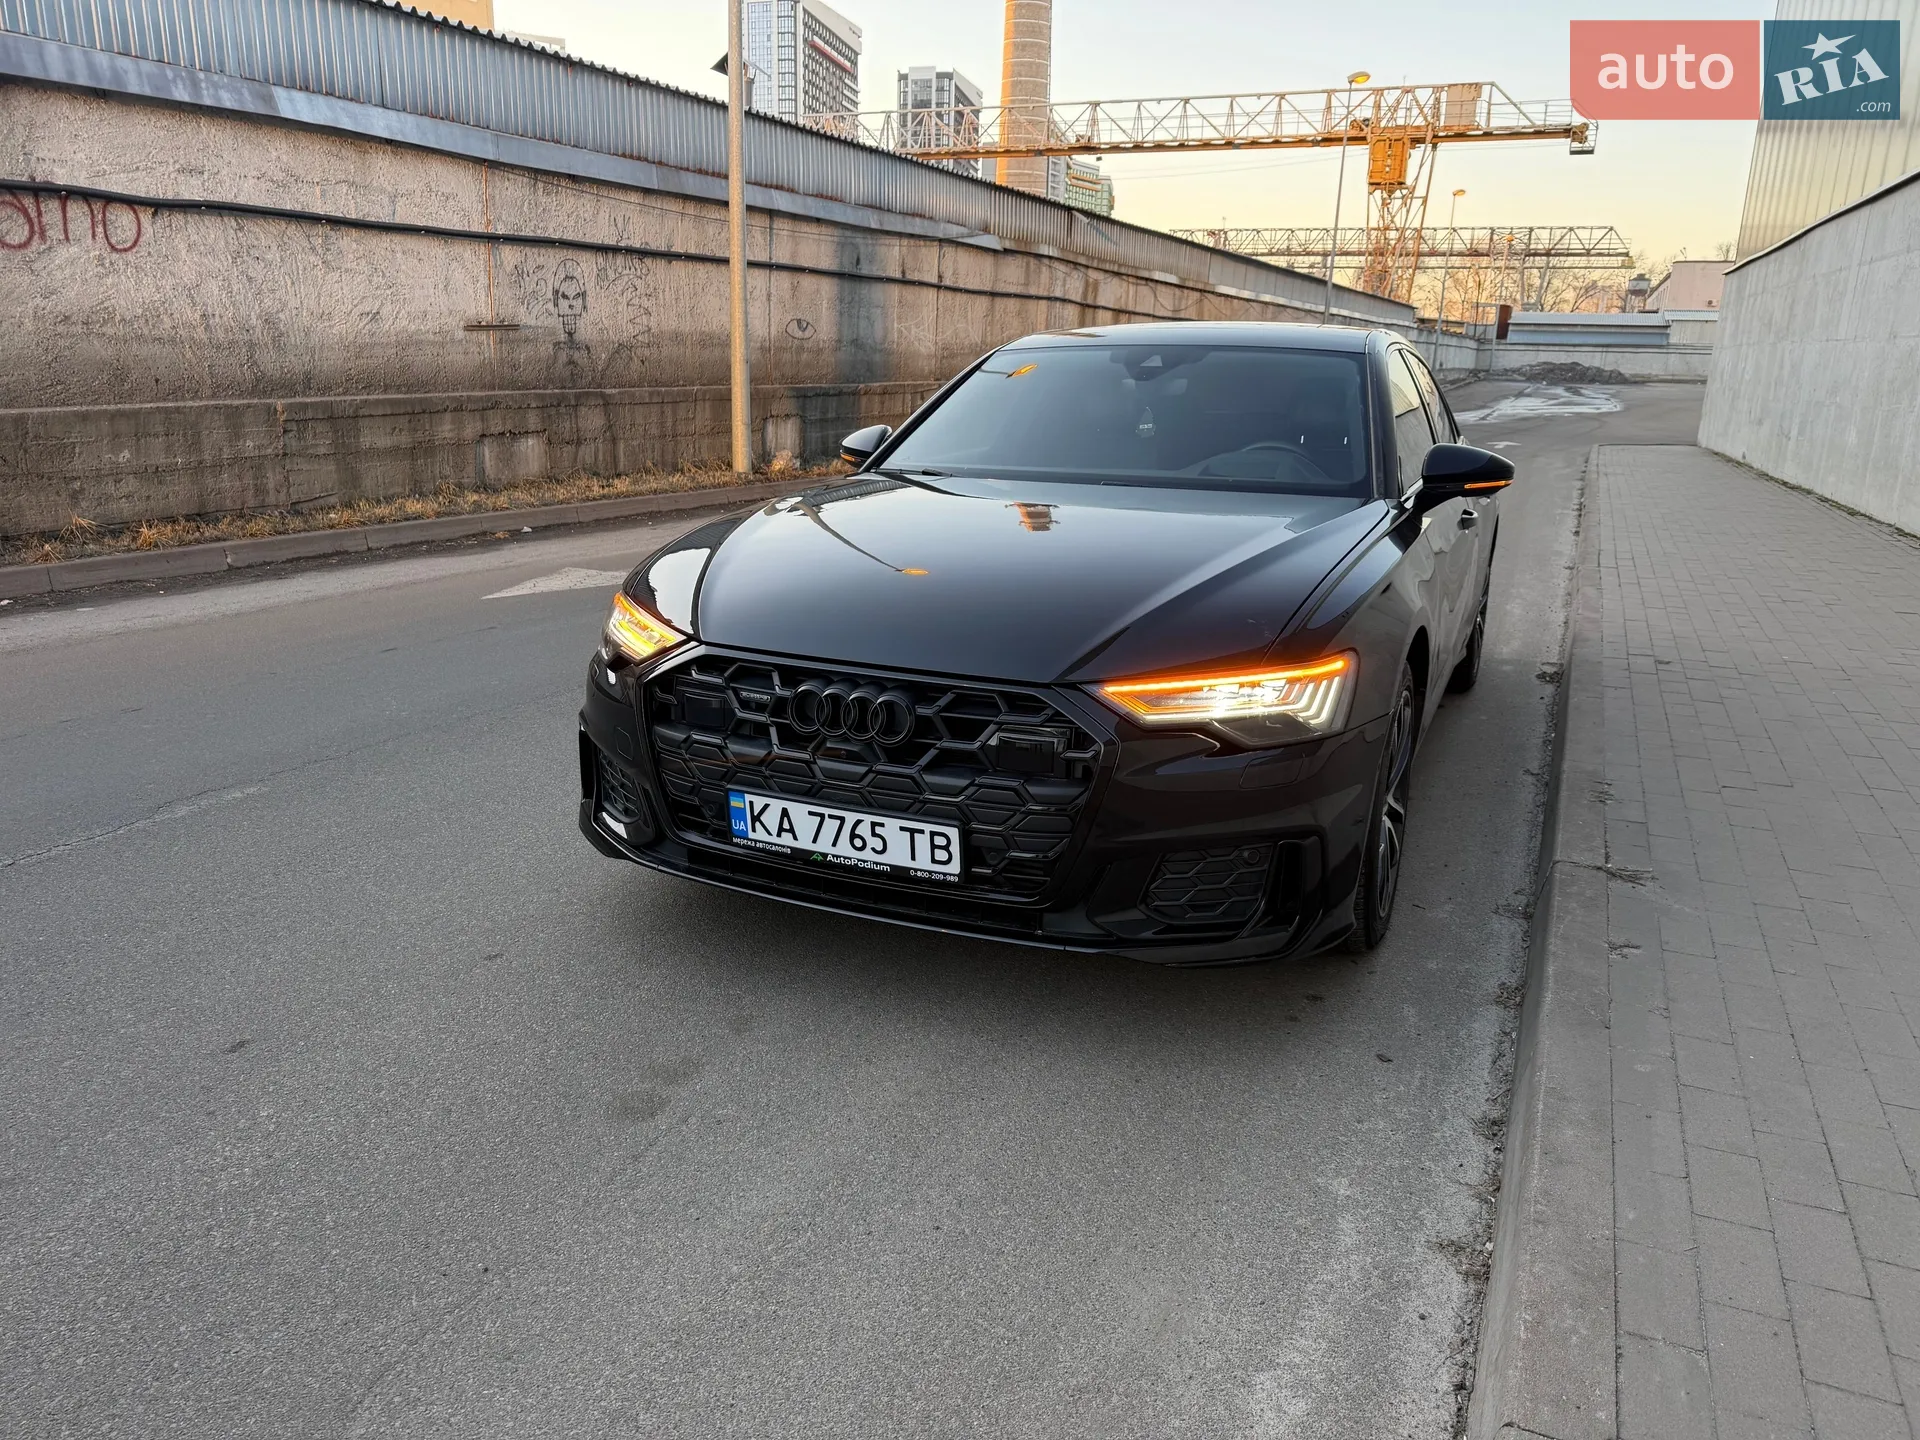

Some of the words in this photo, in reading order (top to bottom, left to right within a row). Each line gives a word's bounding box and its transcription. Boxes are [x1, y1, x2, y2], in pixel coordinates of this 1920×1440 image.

[732, 818, 747, 832] UA
[748, 800, 799, 842] KA
[807, 810, 888, 855] 7765
[899, 825, 953, 867] TB
[826, 854, 890, 872] AutoPodium
[909, 869, 959, 883] 0-800-209-989
